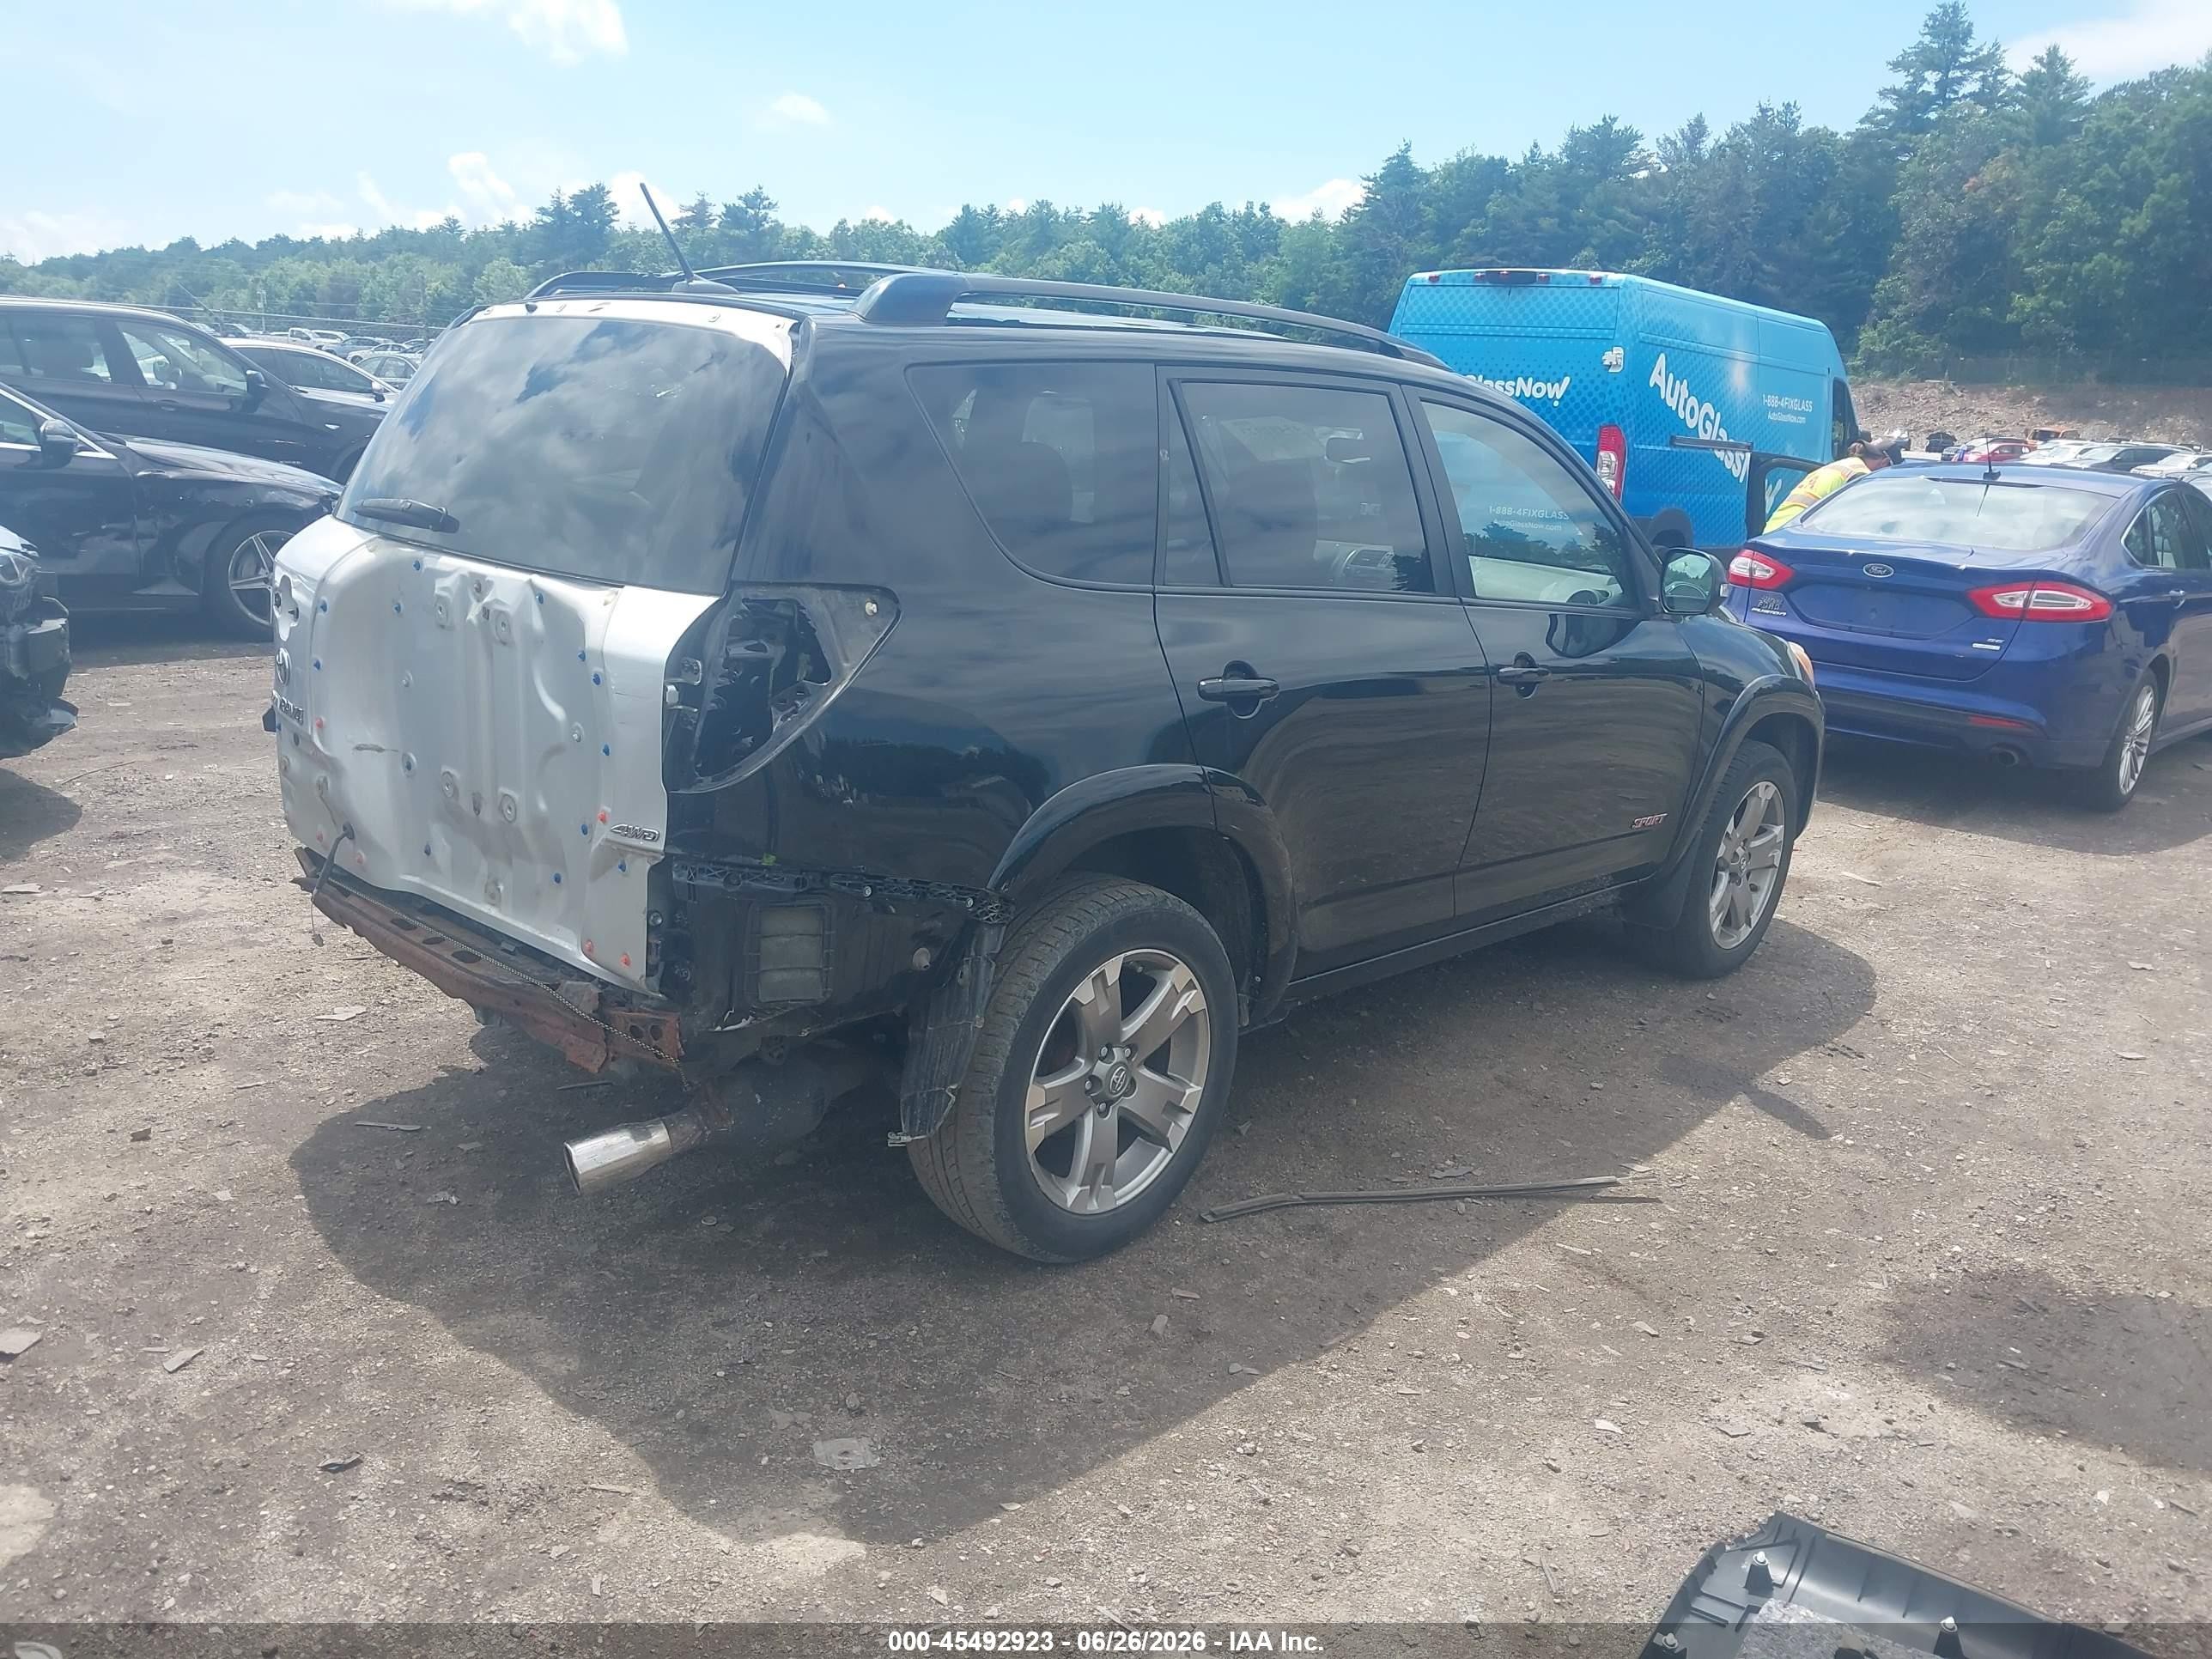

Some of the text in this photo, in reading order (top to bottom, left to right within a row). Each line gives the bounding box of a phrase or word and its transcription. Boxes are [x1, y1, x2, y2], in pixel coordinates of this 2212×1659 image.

[1762, 393, 1814, 413] 1-888-4FIXGLASS
[1489, 506, 1570, 520] 1-888-4FIXGLASS
[611, 823, 660, 842] 4WD
